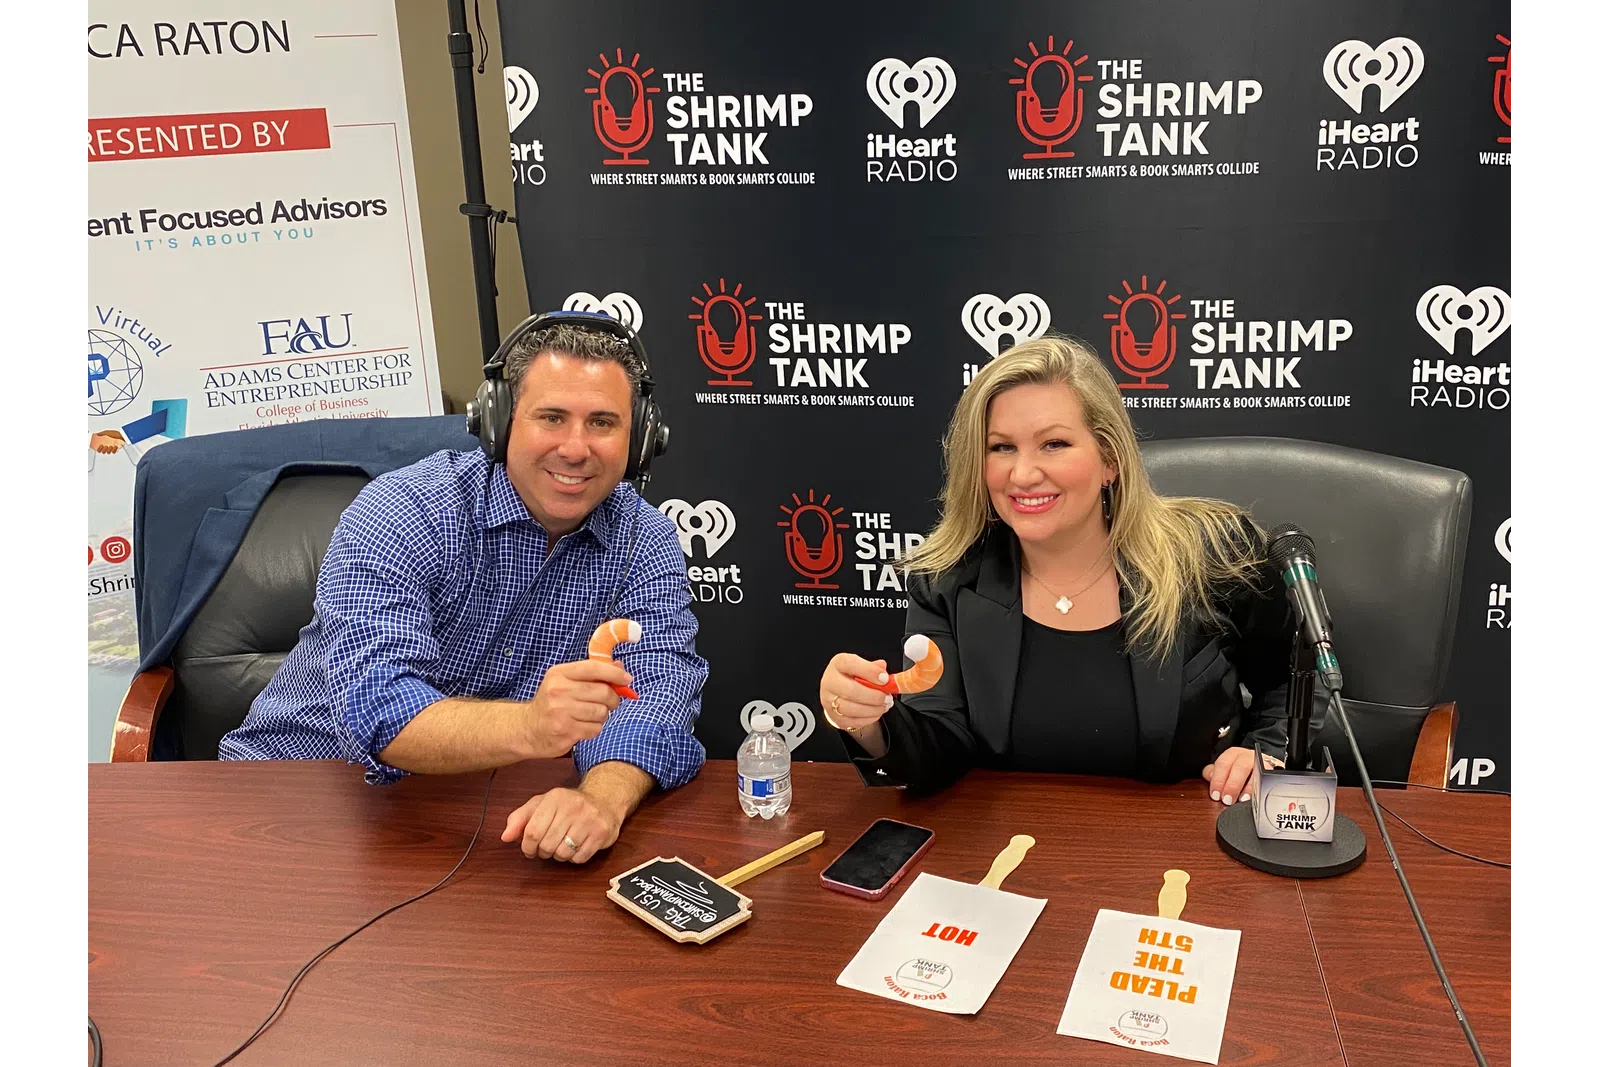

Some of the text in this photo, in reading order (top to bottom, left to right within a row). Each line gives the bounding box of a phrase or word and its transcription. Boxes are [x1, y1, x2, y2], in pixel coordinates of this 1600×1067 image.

[154, 19, 291, 56] RATON
[1098, 59, 1143, 80] THE
[663, 73, 704, 93] THE
[666, 93, 814, 129] SHRIMP
[1098, 79, 1263, 118] SHRIMP
[254, 120, 290, 147] BY
[1096, 121, 1210, 157] TANK
[1319, 117, 1420, 146] iHeart
[666, 132, 770, 166] TANK
[867, 133, 957, 158] iHeart
[1316, 144, 1419, 171] RADIO
[590, 172, 816, 185] WHERE STREET SMARTS & BOOK SMARTS COLLIDE
[866, 159, 958, 183] RADIO
[1008, 162, 1260, 181] WHERE STREET SMARTS & BOOK SMARTS COLLIDE
[139, 202, 263, 233] Focused
[271, 198, 388, 224] Advisors
[135, 227, 314, 252] IT'S ABOUT YOU
[764, 302, 805, 320] THE
[1191, 300, 1234, 319] THE
[96, 305, 172, 358] Virtual
[257, 313, 353, 356] FAU
[768, 323, 912, 354] SHRIMP
[1191, 319, 1354, 354] SHRIMP
[203, 353, 412, 390] ADAMS CENTER FOR
[769, 358, 870, 388] TANK
[1189, 357, 1302, 390] TANK
[206, 371, 413, 409] ENTREPRENEURSHIP
[695, 393, 915, 407] WHERE STREET SMARTS & BOOK SMARTS COLLIDE
[1141, 397, 1177, 409] STREET
[1179, 397, 1221, 409] SMARTS
[1222, 397, 1232, 409] &
[1233, 397, 1263, 408] BOOK
[1264, 396, 1307, 408] SMARTS
[1308, 395, 1351, 408] COLLIDE
[256, 396, 369, 418] College of Business
[852, 512, 891, 529] THE
[783, 594, 815, 606] WHERE
[816, 595, 848, 607] STREET
[849, 597, 886, 608] SMARTS
[887, 598, 895, 609] &
[1276, 813, 1317, 822] SHRIMP
[1276, 821, 1316, 831] TANK
[633, 891, 692, 929] TAG US!
[921, 922, 979, 946] HOT
[1138, 928, 1193, 953] 5TH
[911, 964, 947, 975] SHRIMP
[916, 959, 947, 970] TANK
[1133, 951, 1185, 975] THE
[884, 976, 947, 1001] Boca Raton
[1109, 971, 1198, 1004] PLEAD
[1131, 1010, 1160, 1020] TANK
[1109, 1026, 1170, 1046] Boca Raton
